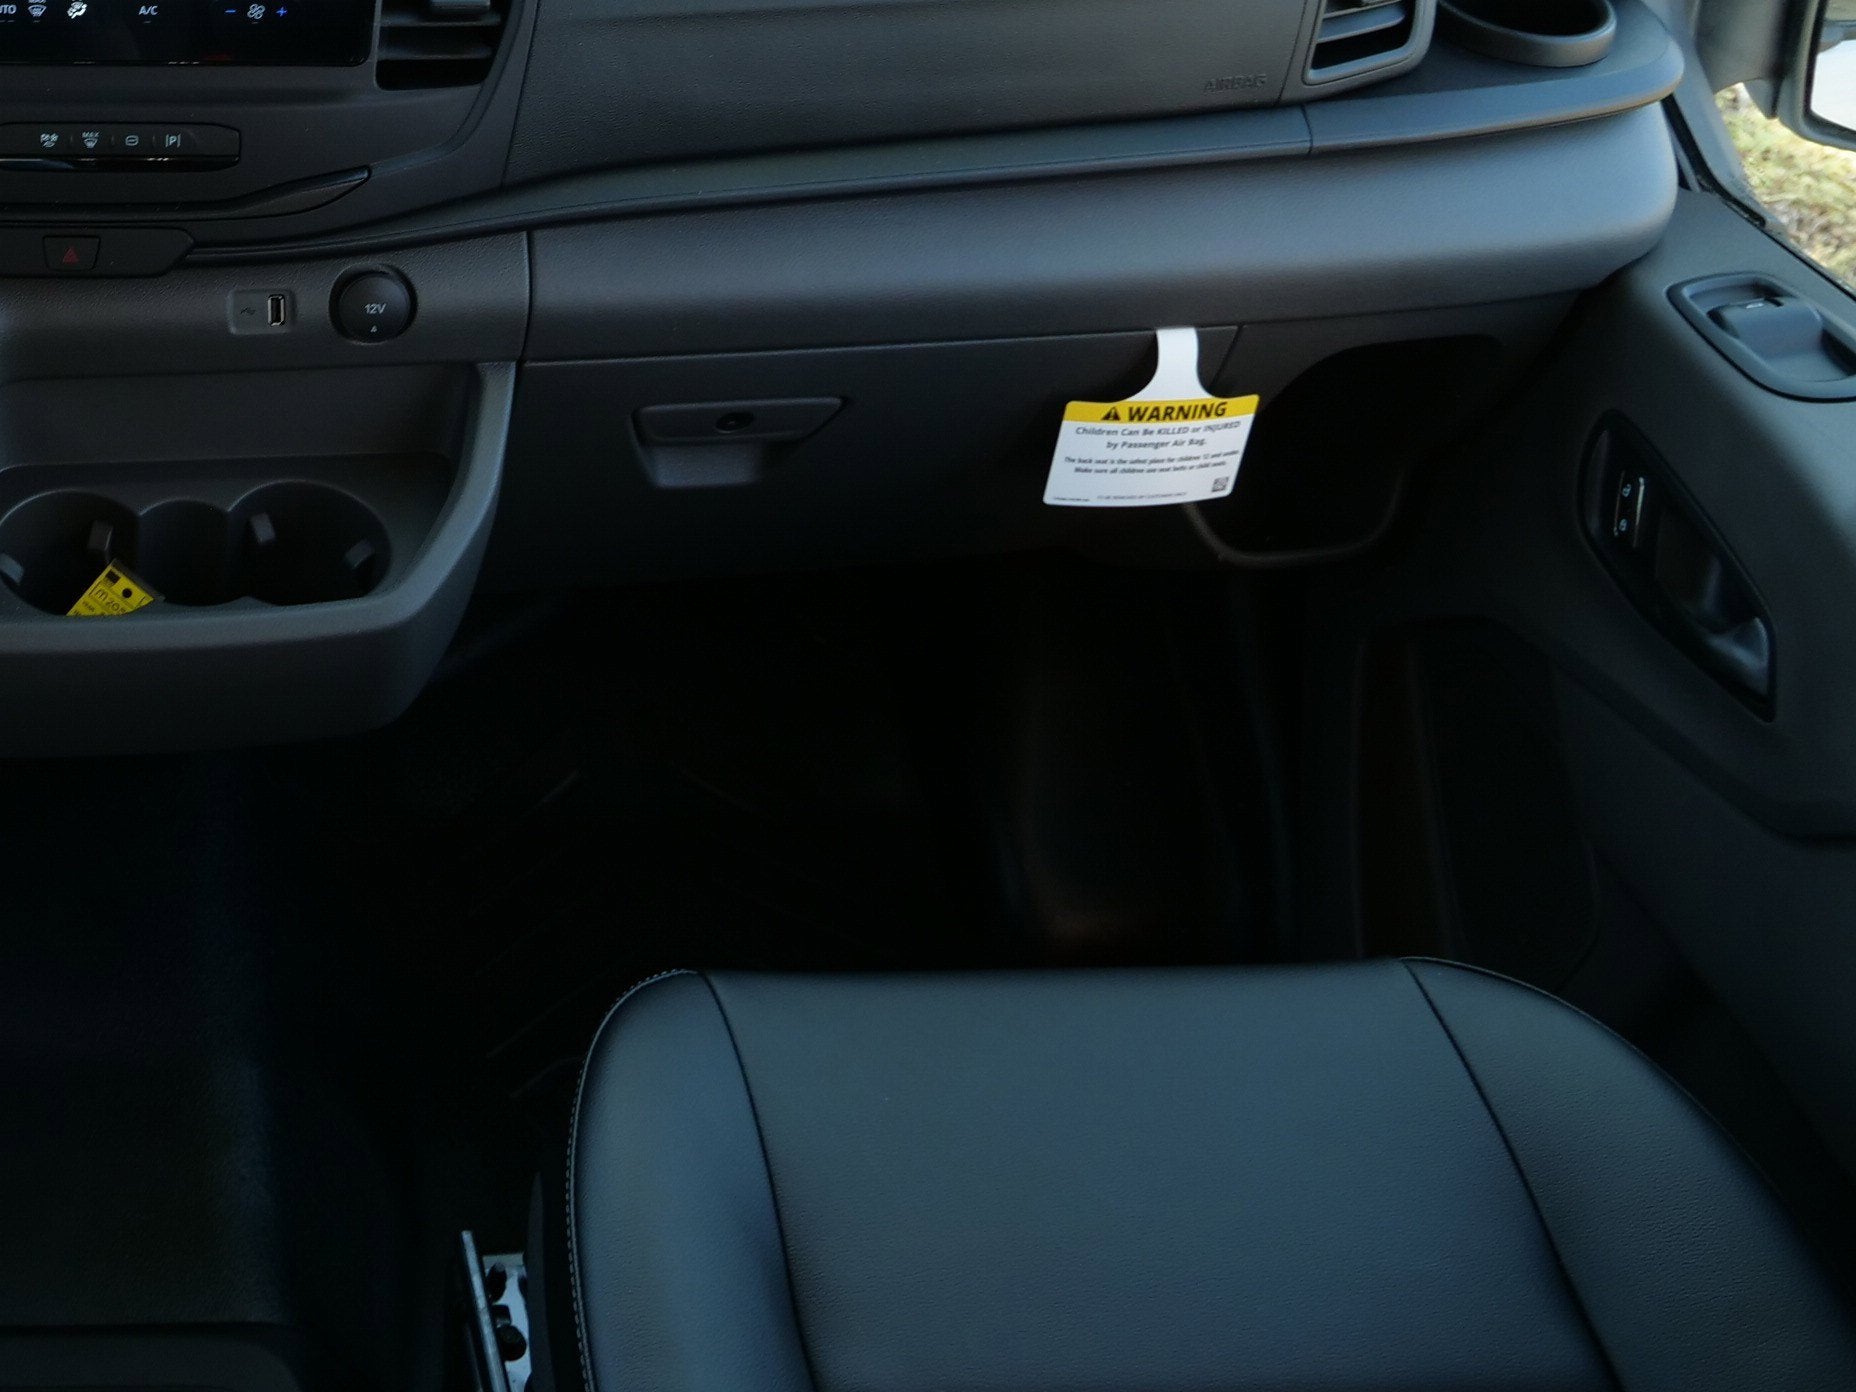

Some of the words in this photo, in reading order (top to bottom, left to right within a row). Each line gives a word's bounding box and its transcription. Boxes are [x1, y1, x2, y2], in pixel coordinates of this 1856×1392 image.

[139, 5, 158, 17] A/C
[364, 302, 386, 315] 12V
[1127, 401, 1228, 422] WARNING
[1075, 425, 1119, 437] Children
[1121, 426, 1140, 437] Can
[1106, 440, 1119, 450] by
[1121, 439, 1171, 451] Passenger
[1172, 438, 1186, 448] Air
